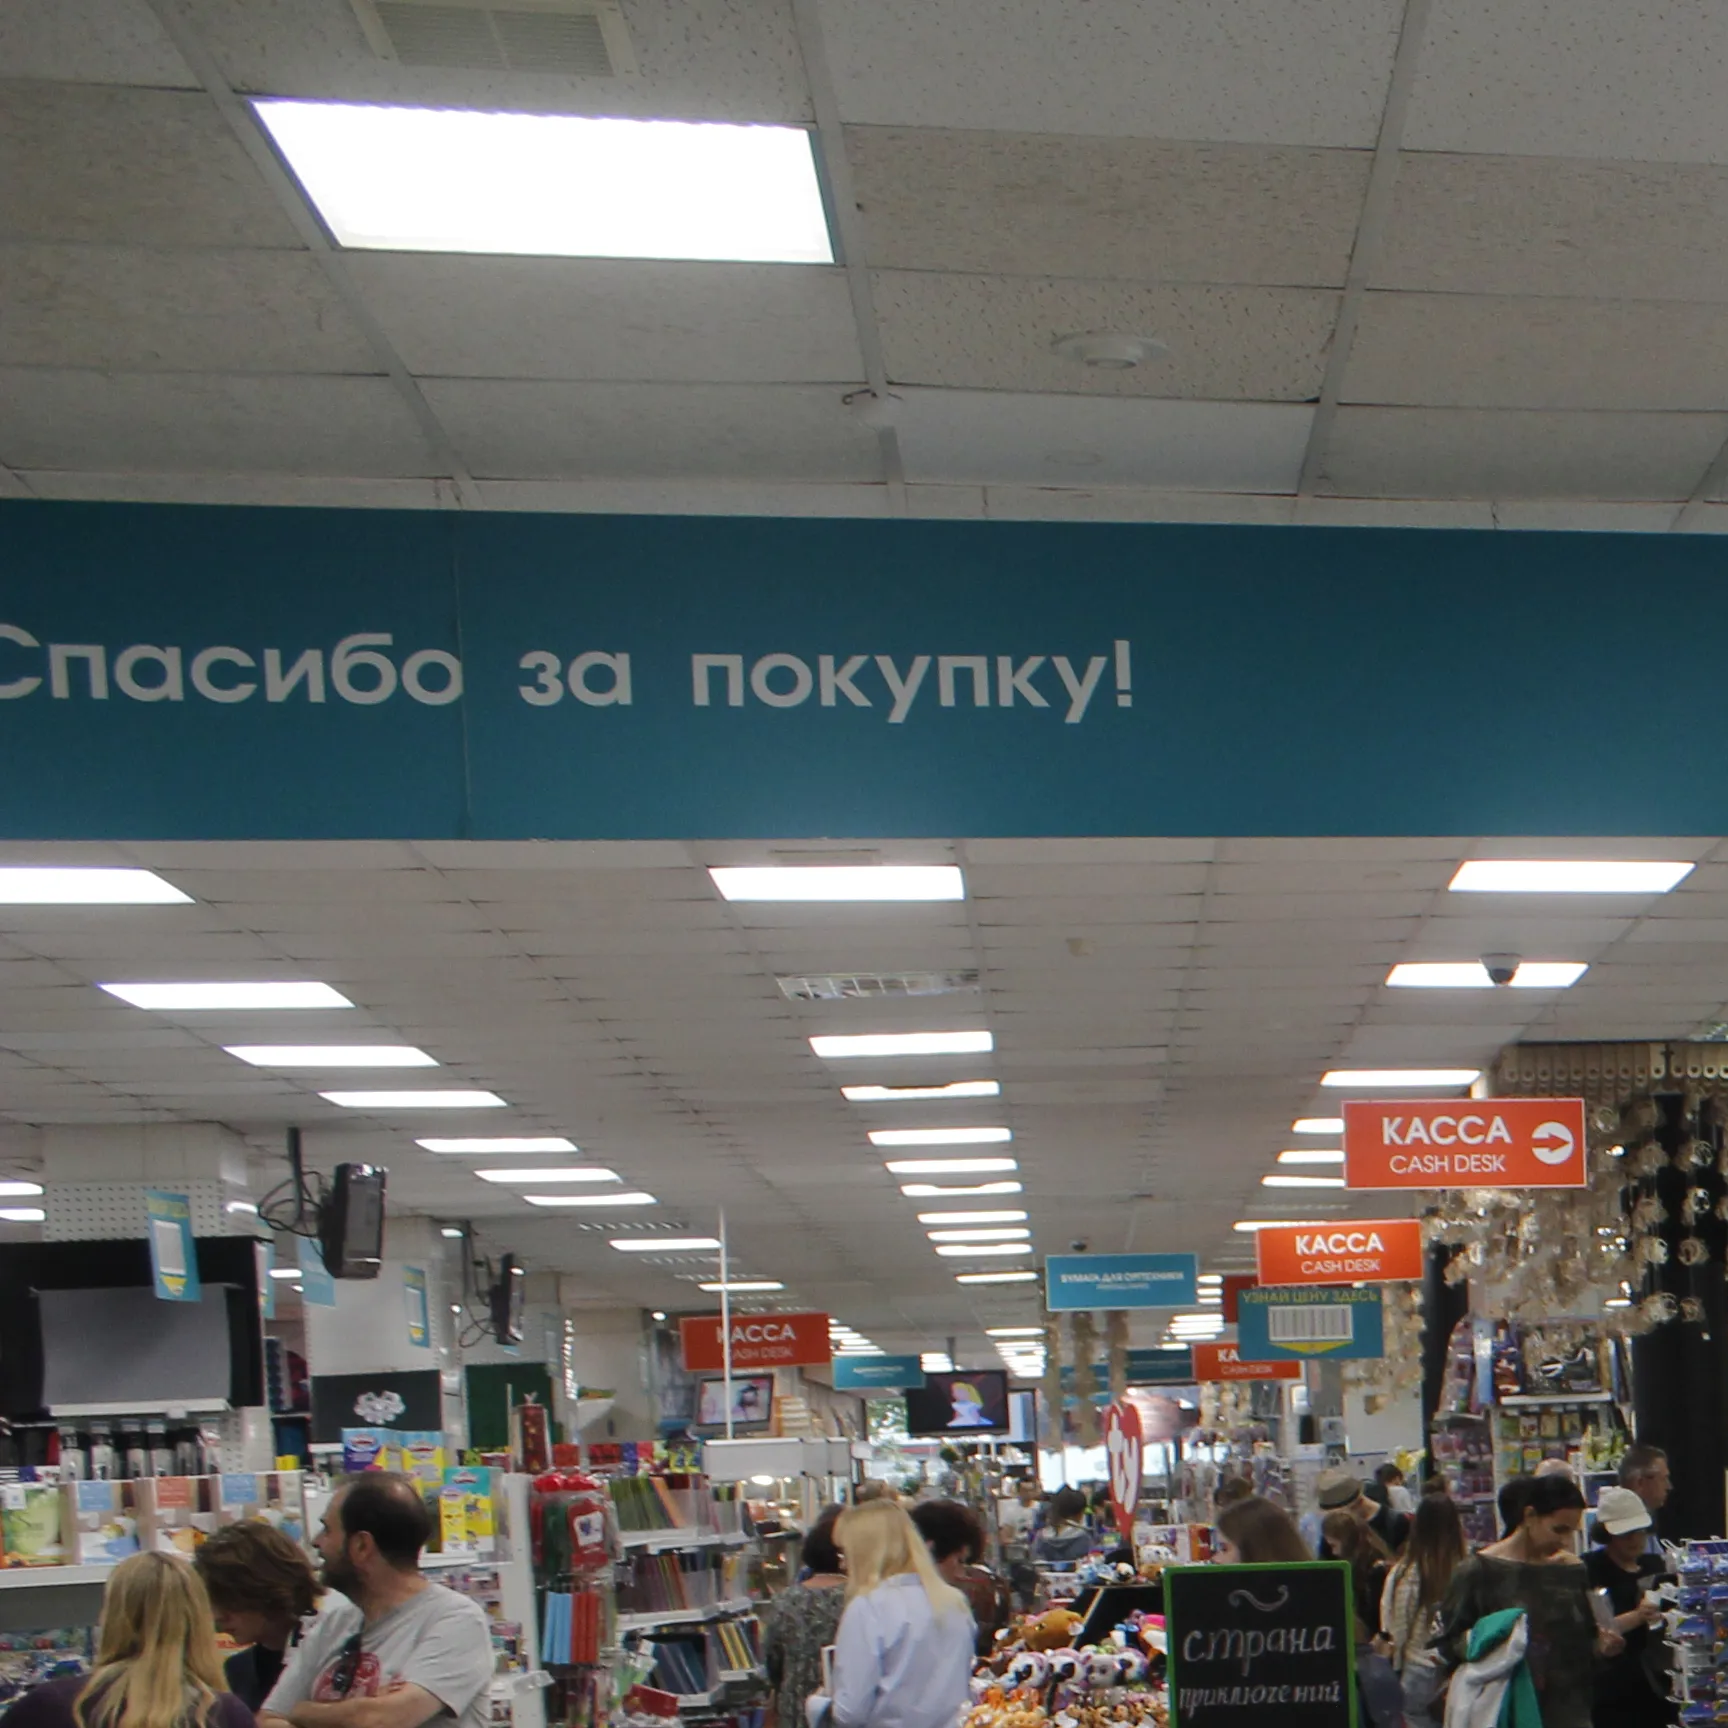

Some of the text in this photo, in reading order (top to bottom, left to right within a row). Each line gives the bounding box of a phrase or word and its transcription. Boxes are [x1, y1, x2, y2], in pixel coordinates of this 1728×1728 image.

[0, 621, 1134, 724] Спасибо за покупку!
[1381, 1115, 1513, 1146] КАССА
[1389, 1152, 1507, 1175] CASH DESK
[1294, 1231, 1385, 1257] КАССА
[1300, 1257, 1381, 1276] CASH DESK
[1182, 1620, 1336, 1676] страна
